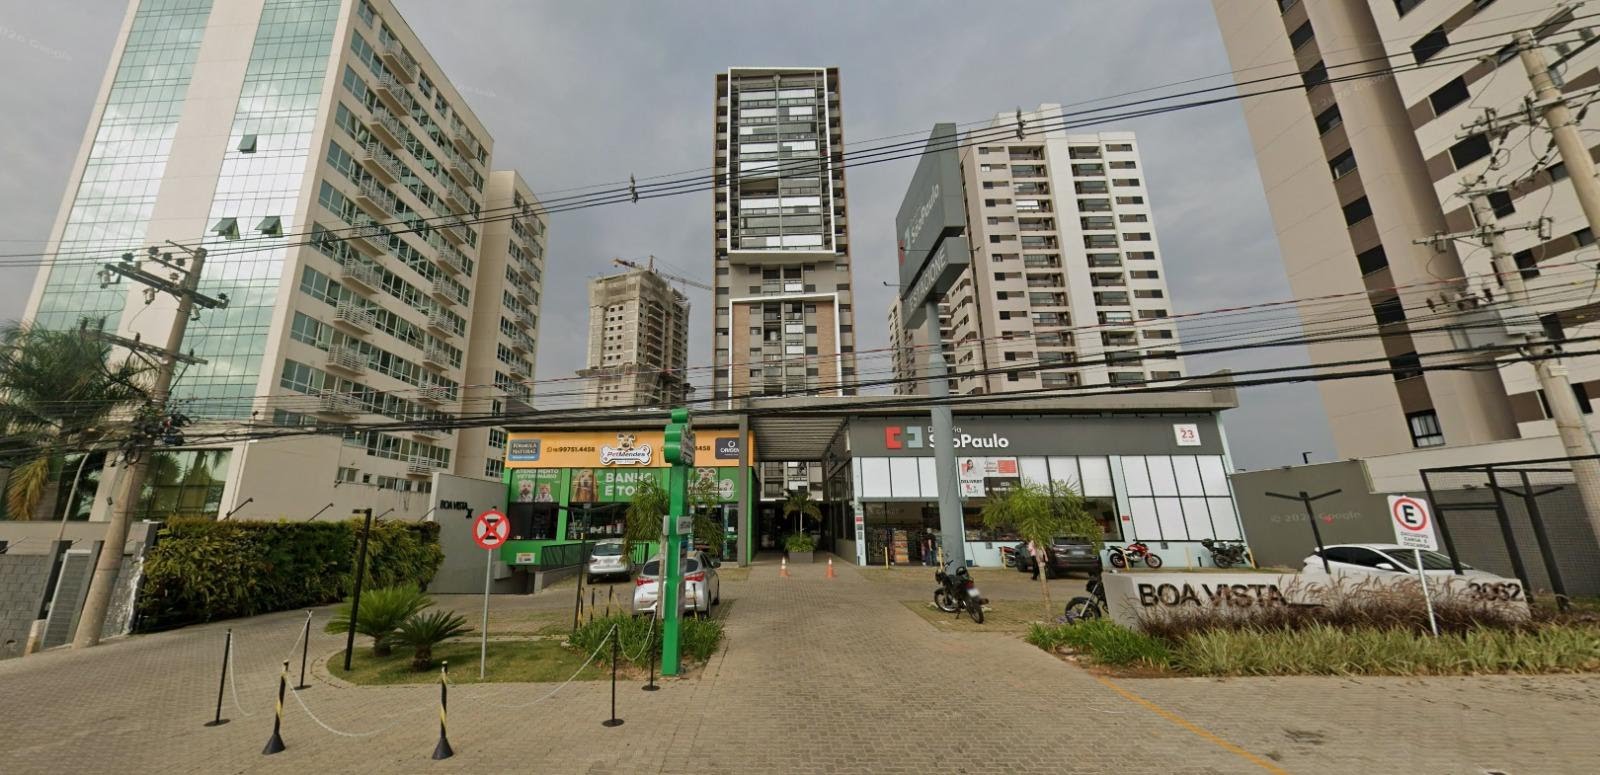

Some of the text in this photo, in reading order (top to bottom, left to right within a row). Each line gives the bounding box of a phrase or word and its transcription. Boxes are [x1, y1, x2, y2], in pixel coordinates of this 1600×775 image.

[908, 246, 947, 313] ESTACIONE
[928, 433, 1009, 448] SoPaulo
[1181, 429, 1194, 438] 23
[1402, 504, 1417, 524] E
[1138, 583, 1288, 607] BOA VISTA
